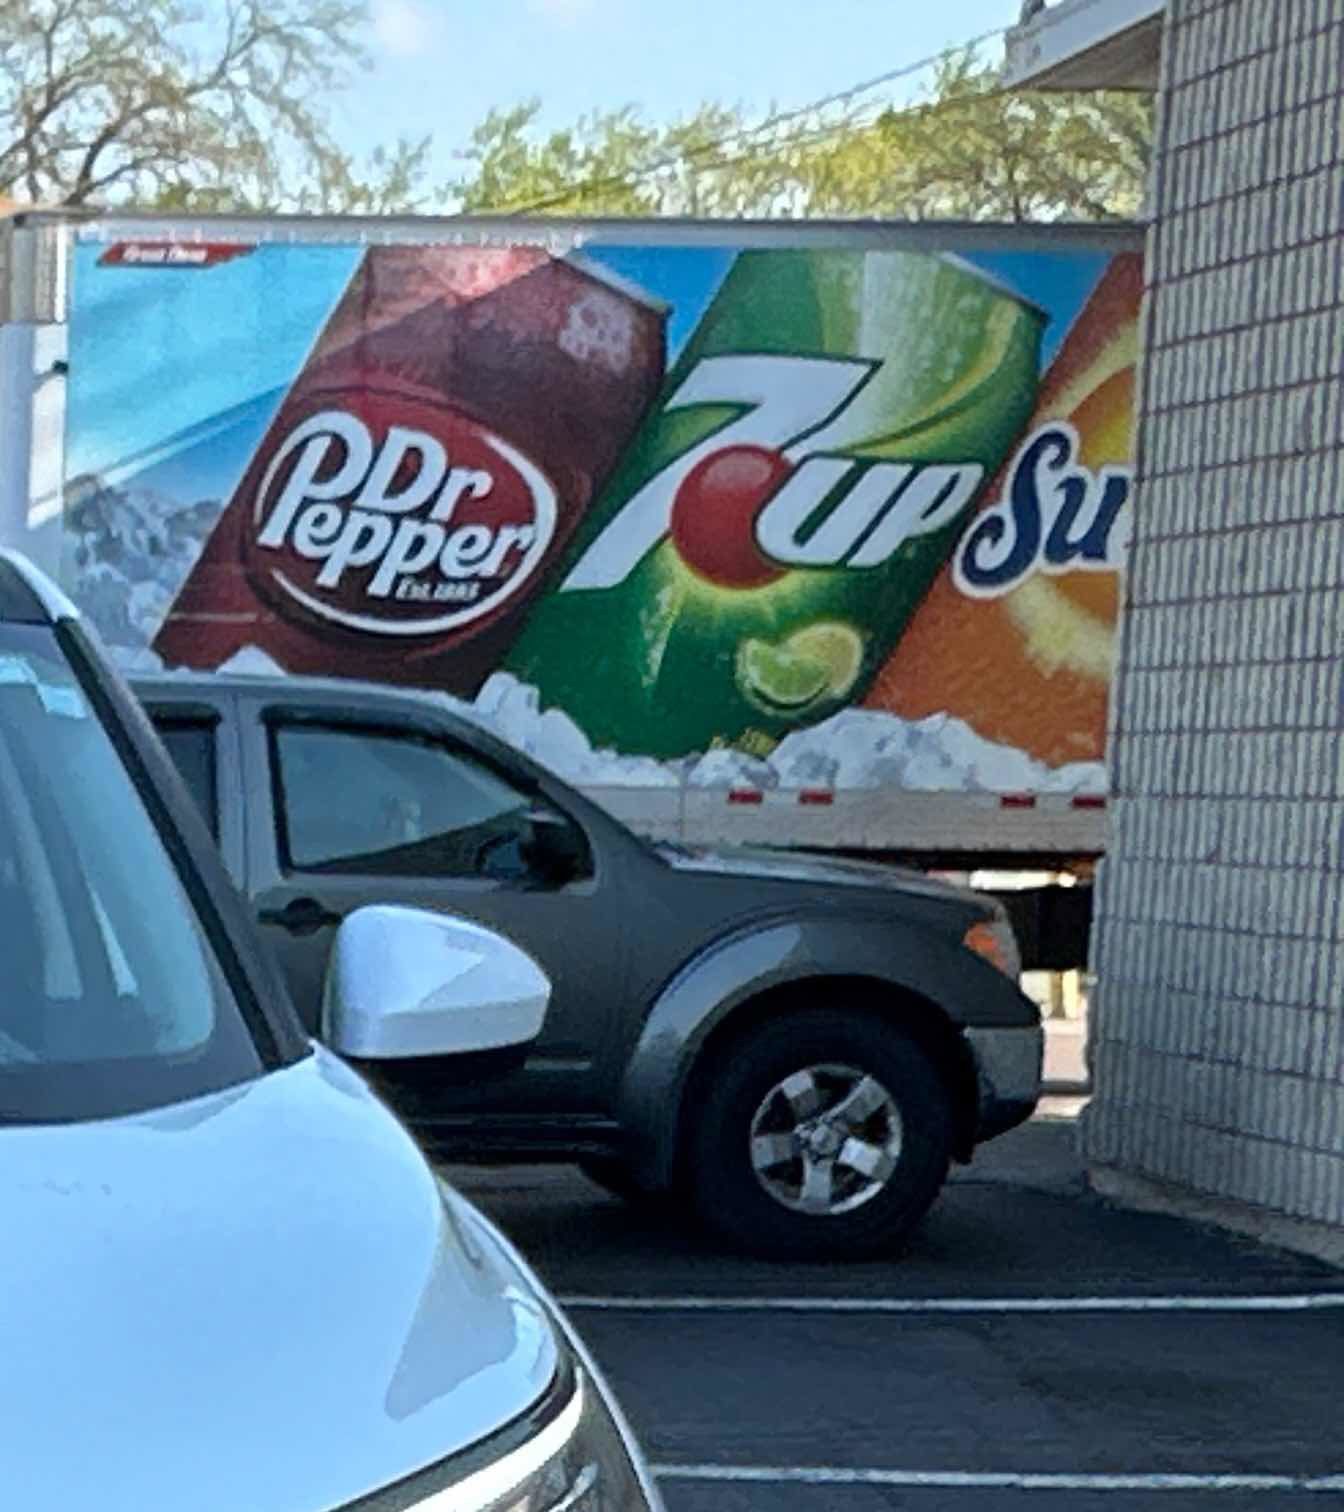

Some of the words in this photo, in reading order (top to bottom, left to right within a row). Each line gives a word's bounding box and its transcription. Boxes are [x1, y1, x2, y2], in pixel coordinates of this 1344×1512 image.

[257, 410, 538, 597] Pepper
[354, 426, 494, 522] Dr
[960, 424, 1132, 590] Su
